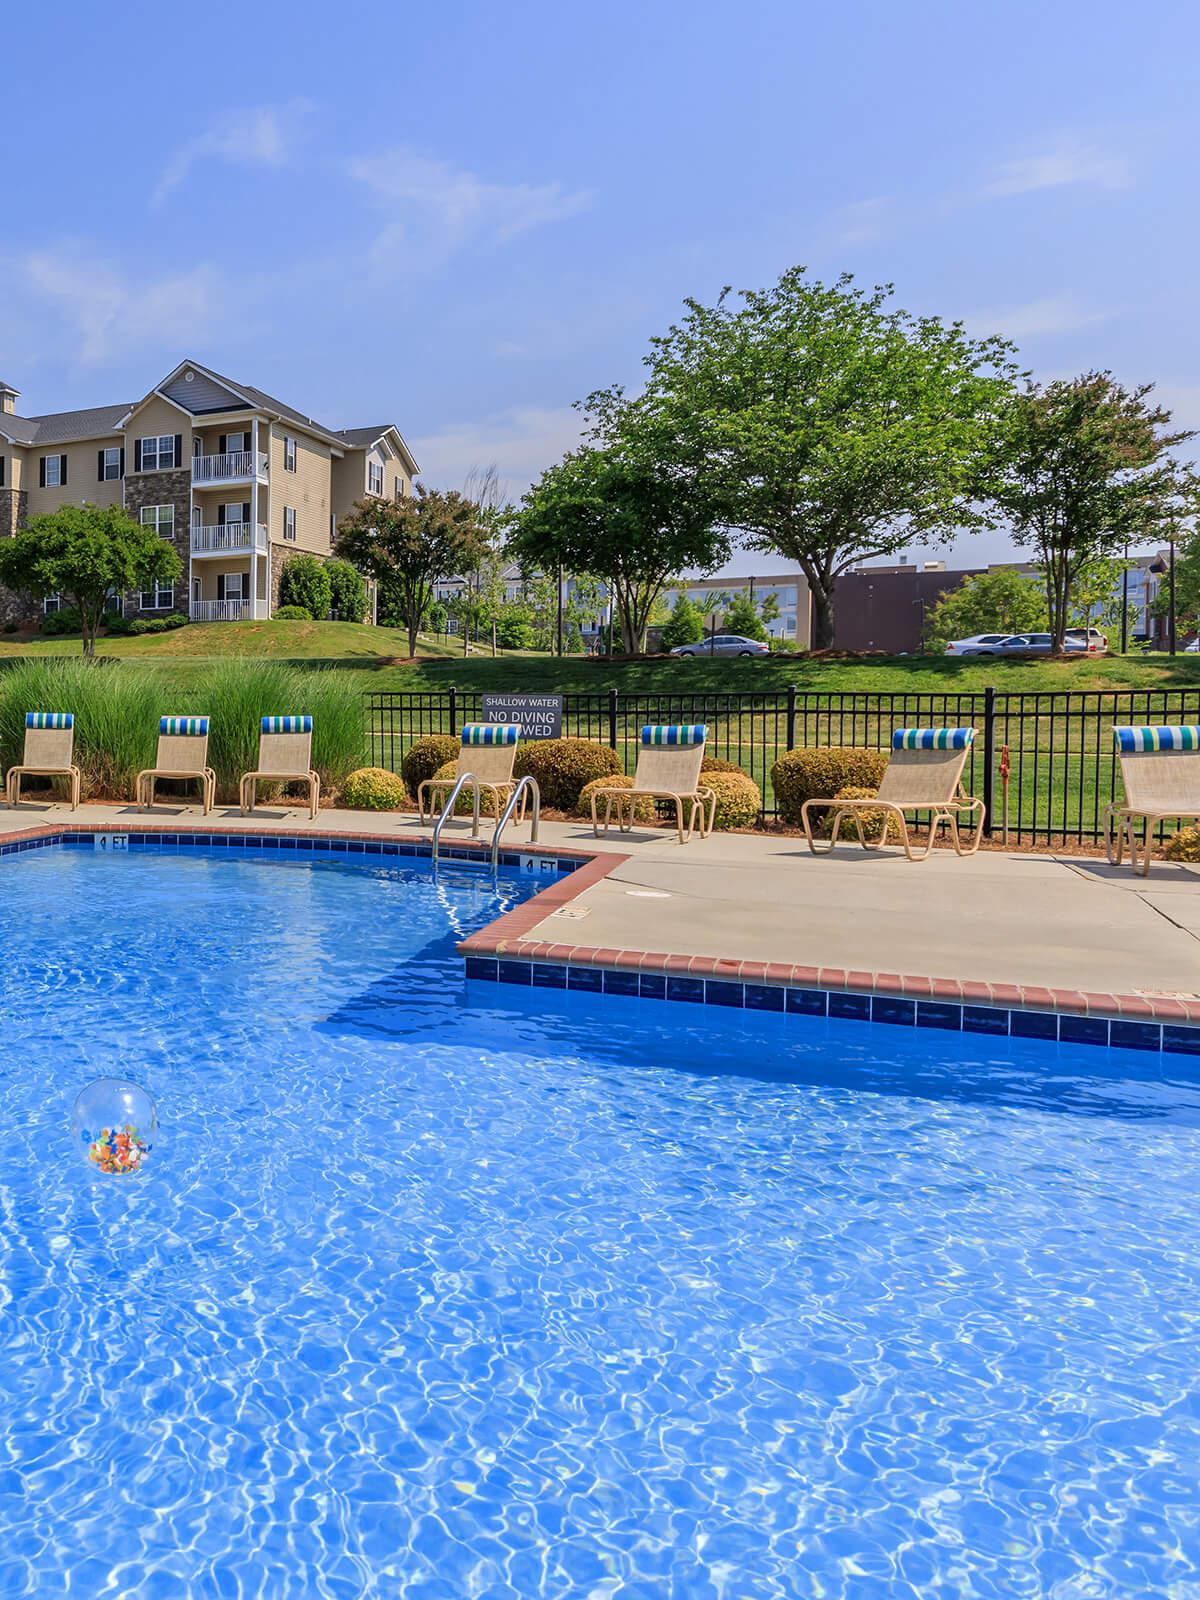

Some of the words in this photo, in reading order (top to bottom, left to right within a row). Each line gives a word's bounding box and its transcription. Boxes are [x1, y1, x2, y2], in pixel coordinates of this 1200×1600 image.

[486, 698, 526, 706] SHALLOW
[528, 699, 559, 707] WATER
[489, 711, 507, 722] NO
[511, 711, 555, 723] DIVING
